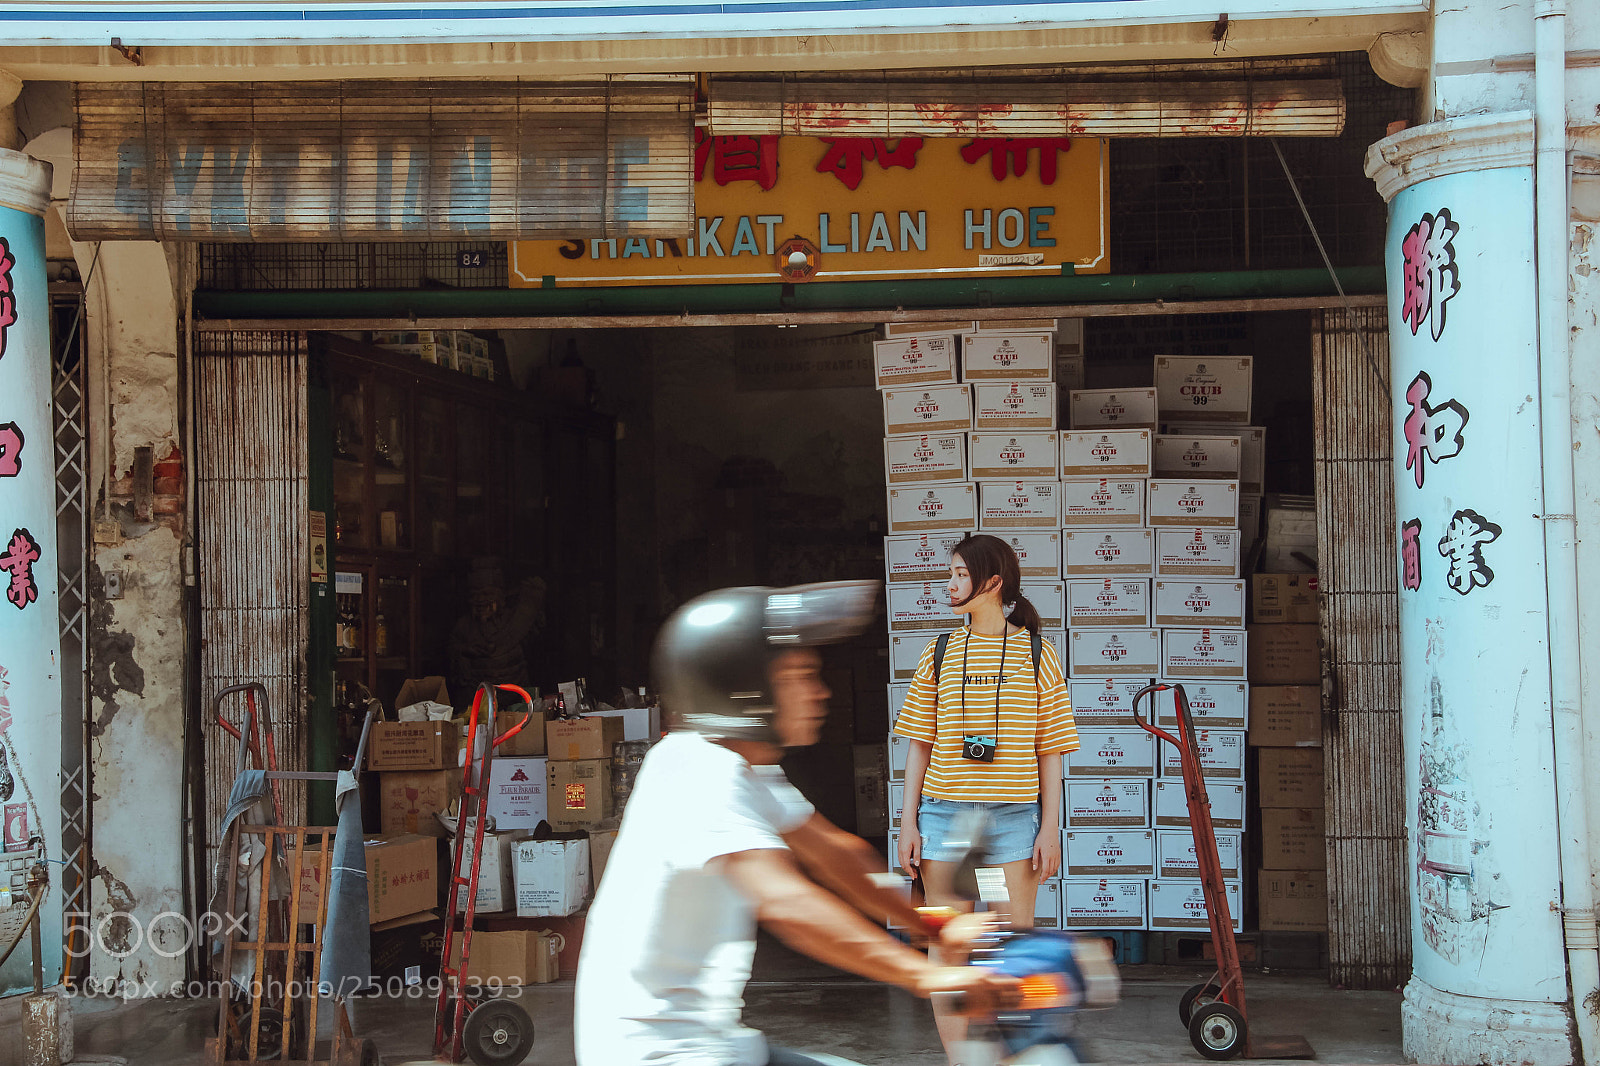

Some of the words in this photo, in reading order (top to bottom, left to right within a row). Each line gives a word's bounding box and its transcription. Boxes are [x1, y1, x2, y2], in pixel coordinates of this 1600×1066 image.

[819, 211, 927, 254] LIAN
[964, 206, 1056, 250] HOE
[462, 253, 481, 266] 84
[1180, 386, 1222, 395] CLUB
[964, 676, 1008, 685] WHITE
